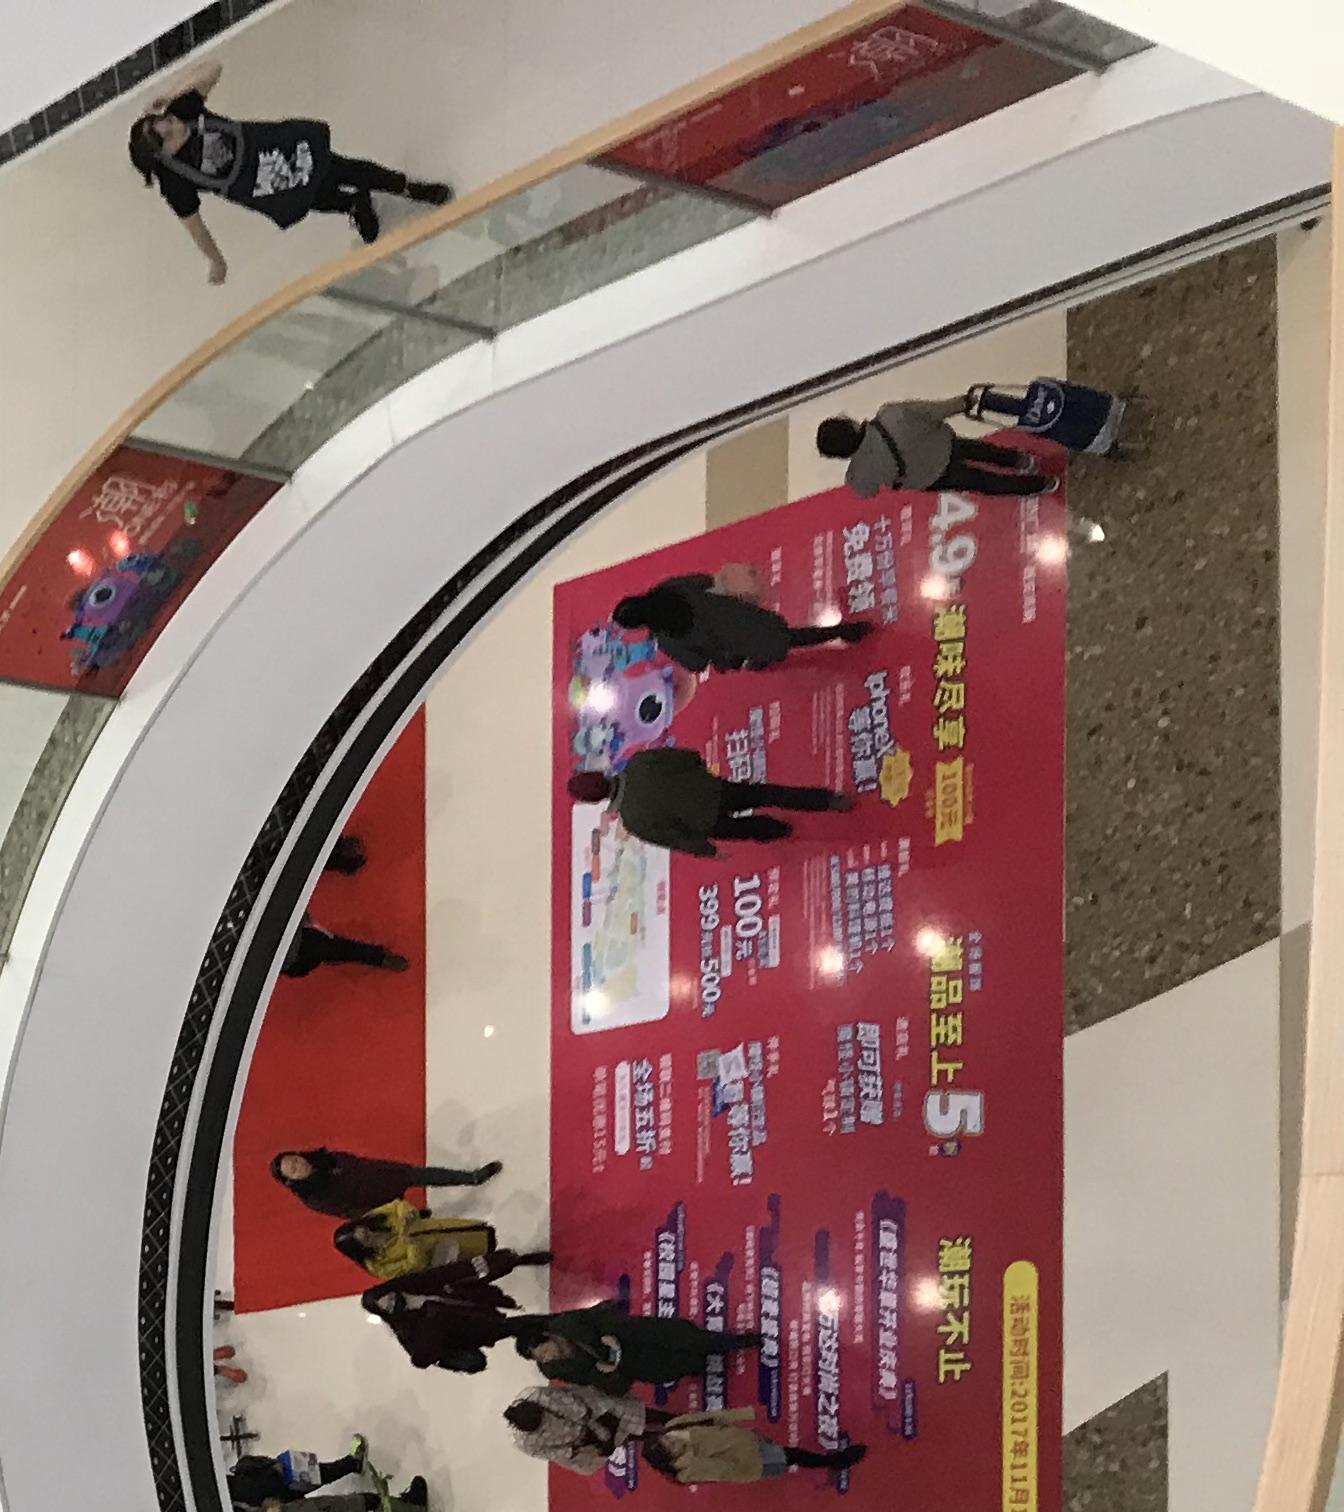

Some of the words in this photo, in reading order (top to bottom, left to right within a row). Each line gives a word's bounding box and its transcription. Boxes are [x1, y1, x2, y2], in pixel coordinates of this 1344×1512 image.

[841, 521, 875, 614] 免费领
[932, 605, 966, 751] 潮味尽享
[731, 872, 762, 961] 100元
[856, 1021, 883, 1126] 即可获赠
[928, 936, 963, 1087] 潮品至上
[934, 1236, 972, 1386] 潮玩不止
